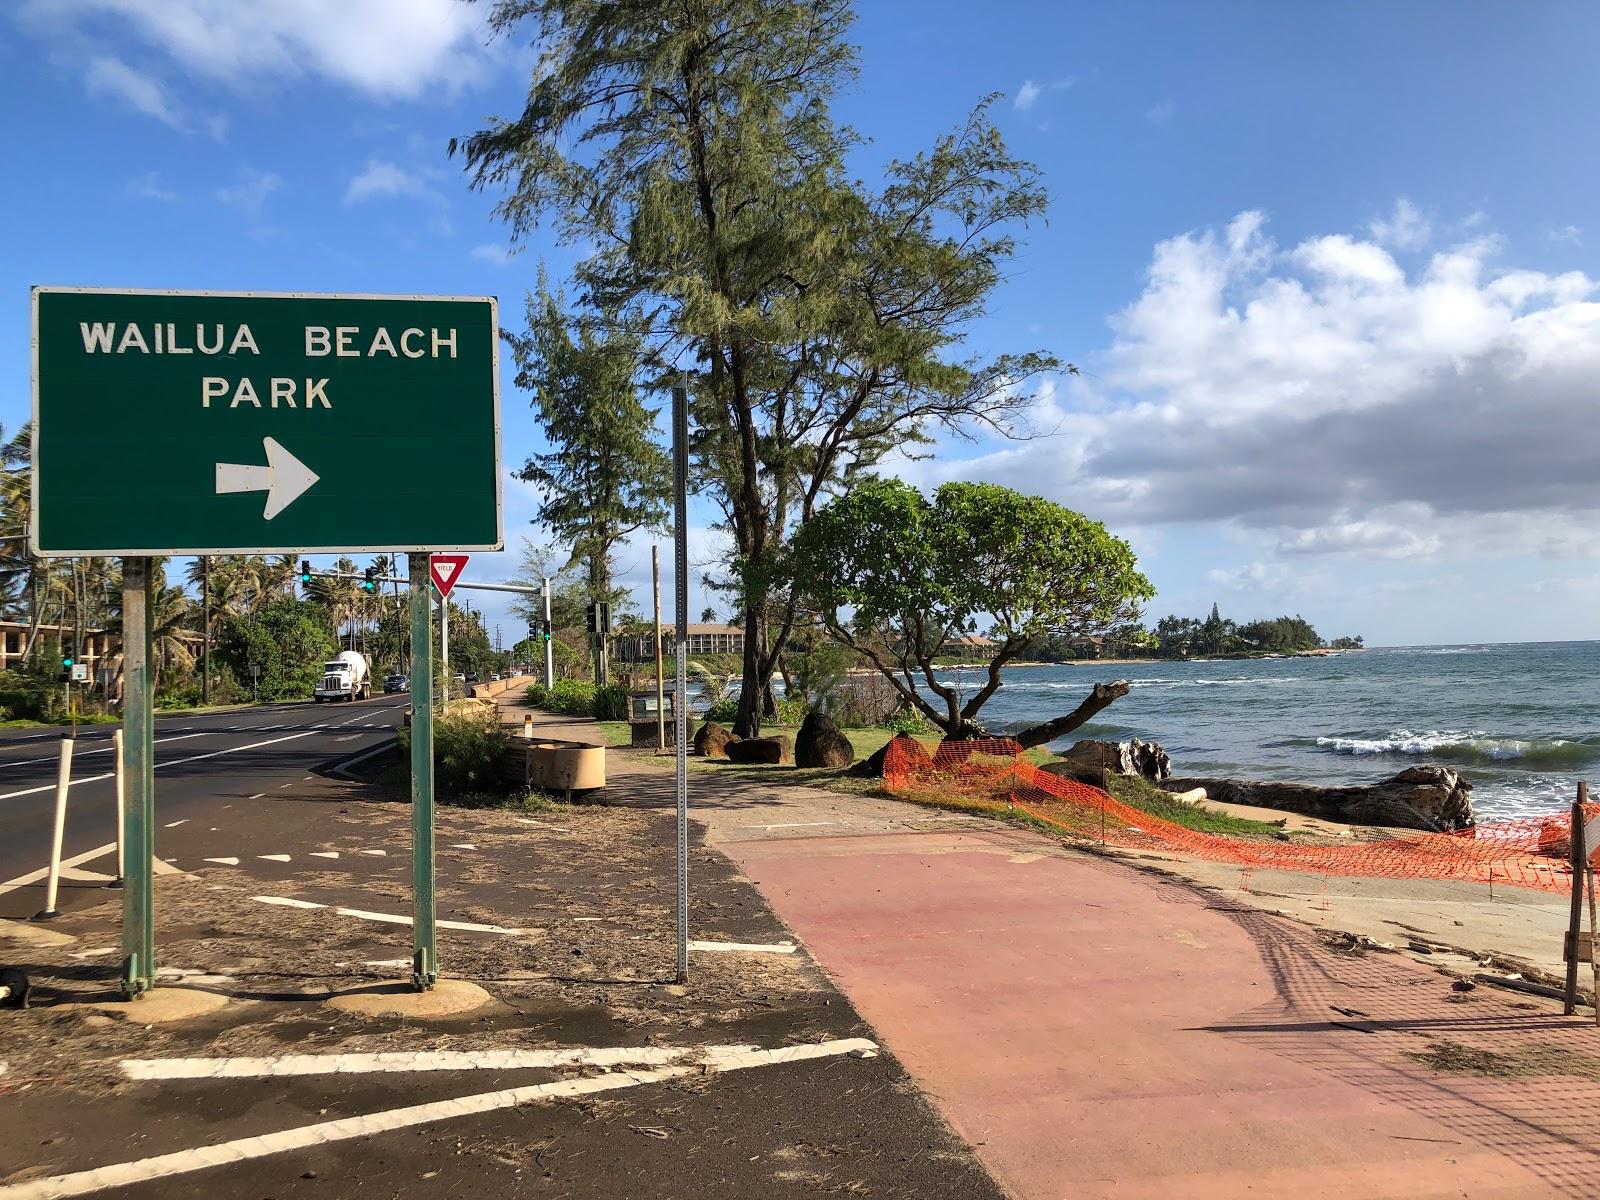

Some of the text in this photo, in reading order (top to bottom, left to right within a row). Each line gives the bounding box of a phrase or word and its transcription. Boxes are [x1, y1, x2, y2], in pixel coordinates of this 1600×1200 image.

[80, 322, 457, 358] WAILUA BEACH
[202, 377, 332, 409] PARK
